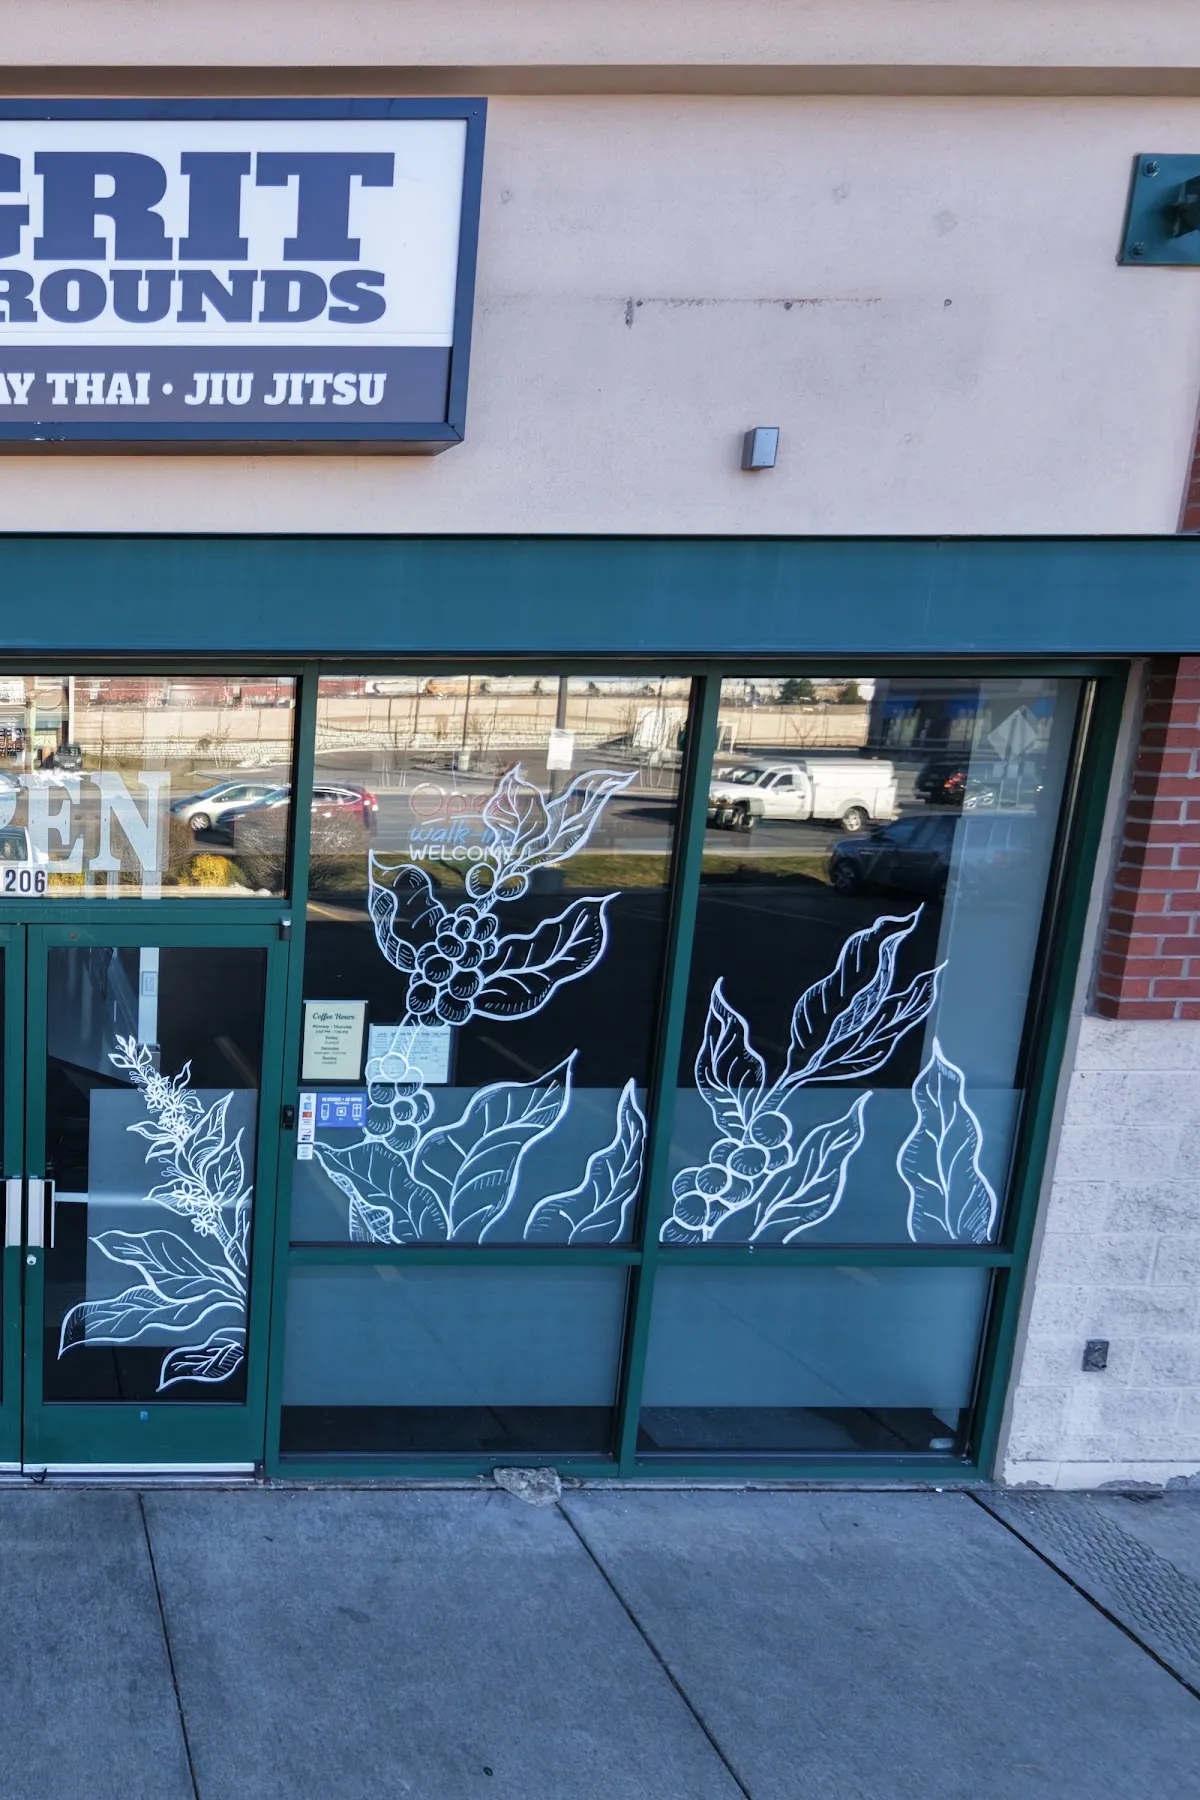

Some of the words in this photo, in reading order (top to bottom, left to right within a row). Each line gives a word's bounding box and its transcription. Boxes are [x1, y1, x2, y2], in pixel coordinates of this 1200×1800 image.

[45, 371, 150, 407] THAI
[184, 371, 253, 407] JIU
[263, 371, 387, 407] JITSU
[409, 844, 514, 862] WELCOME
[4, 869, 46, 894] 206
[312, 1013, 333, 1022] Coffee
[334, 1013, 355, 1021] Hours
